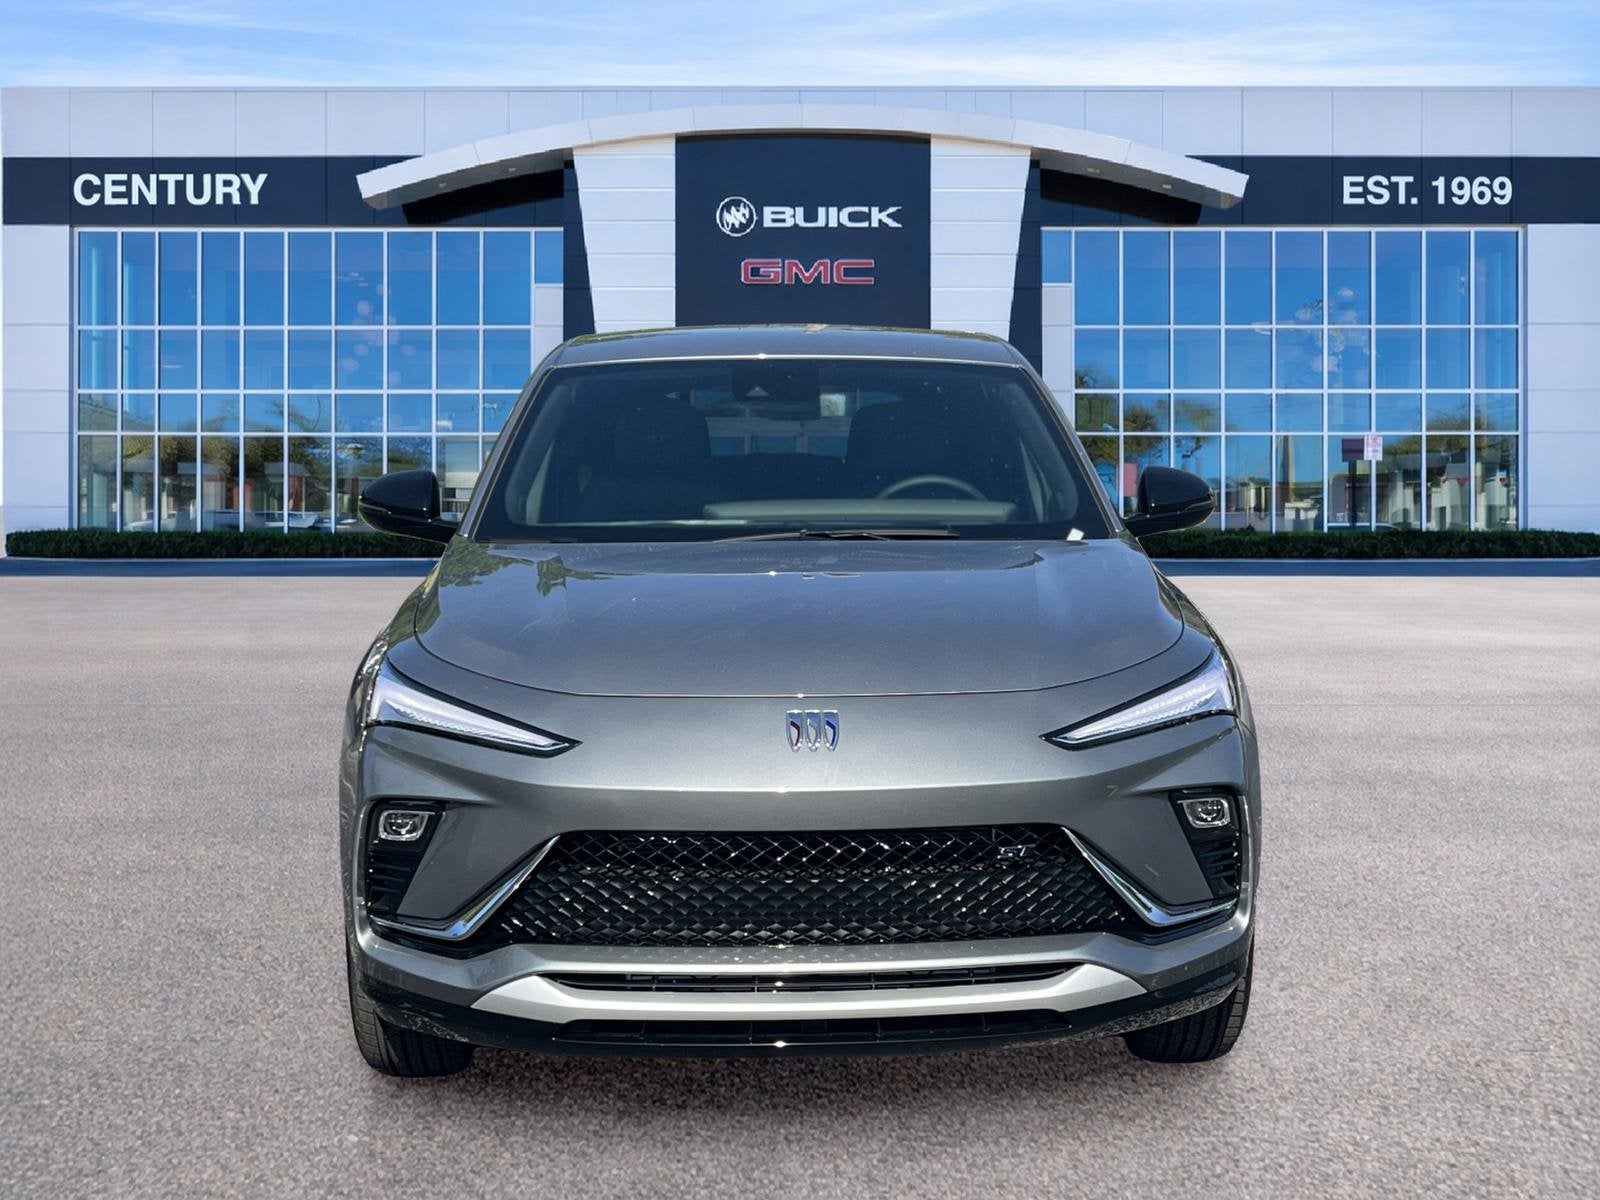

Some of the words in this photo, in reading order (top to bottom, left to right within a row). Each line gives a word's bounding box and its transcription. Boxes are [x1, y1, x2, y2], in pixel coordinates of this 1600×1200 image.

[73, 173, 268, 206] CENTURY
[1342, 175, 1418, 205] EST.
[1431, 175, 1513, 205] 1969
[762, 205, 902, 228] BUICK
[740, 257, 875, 285] GMC
